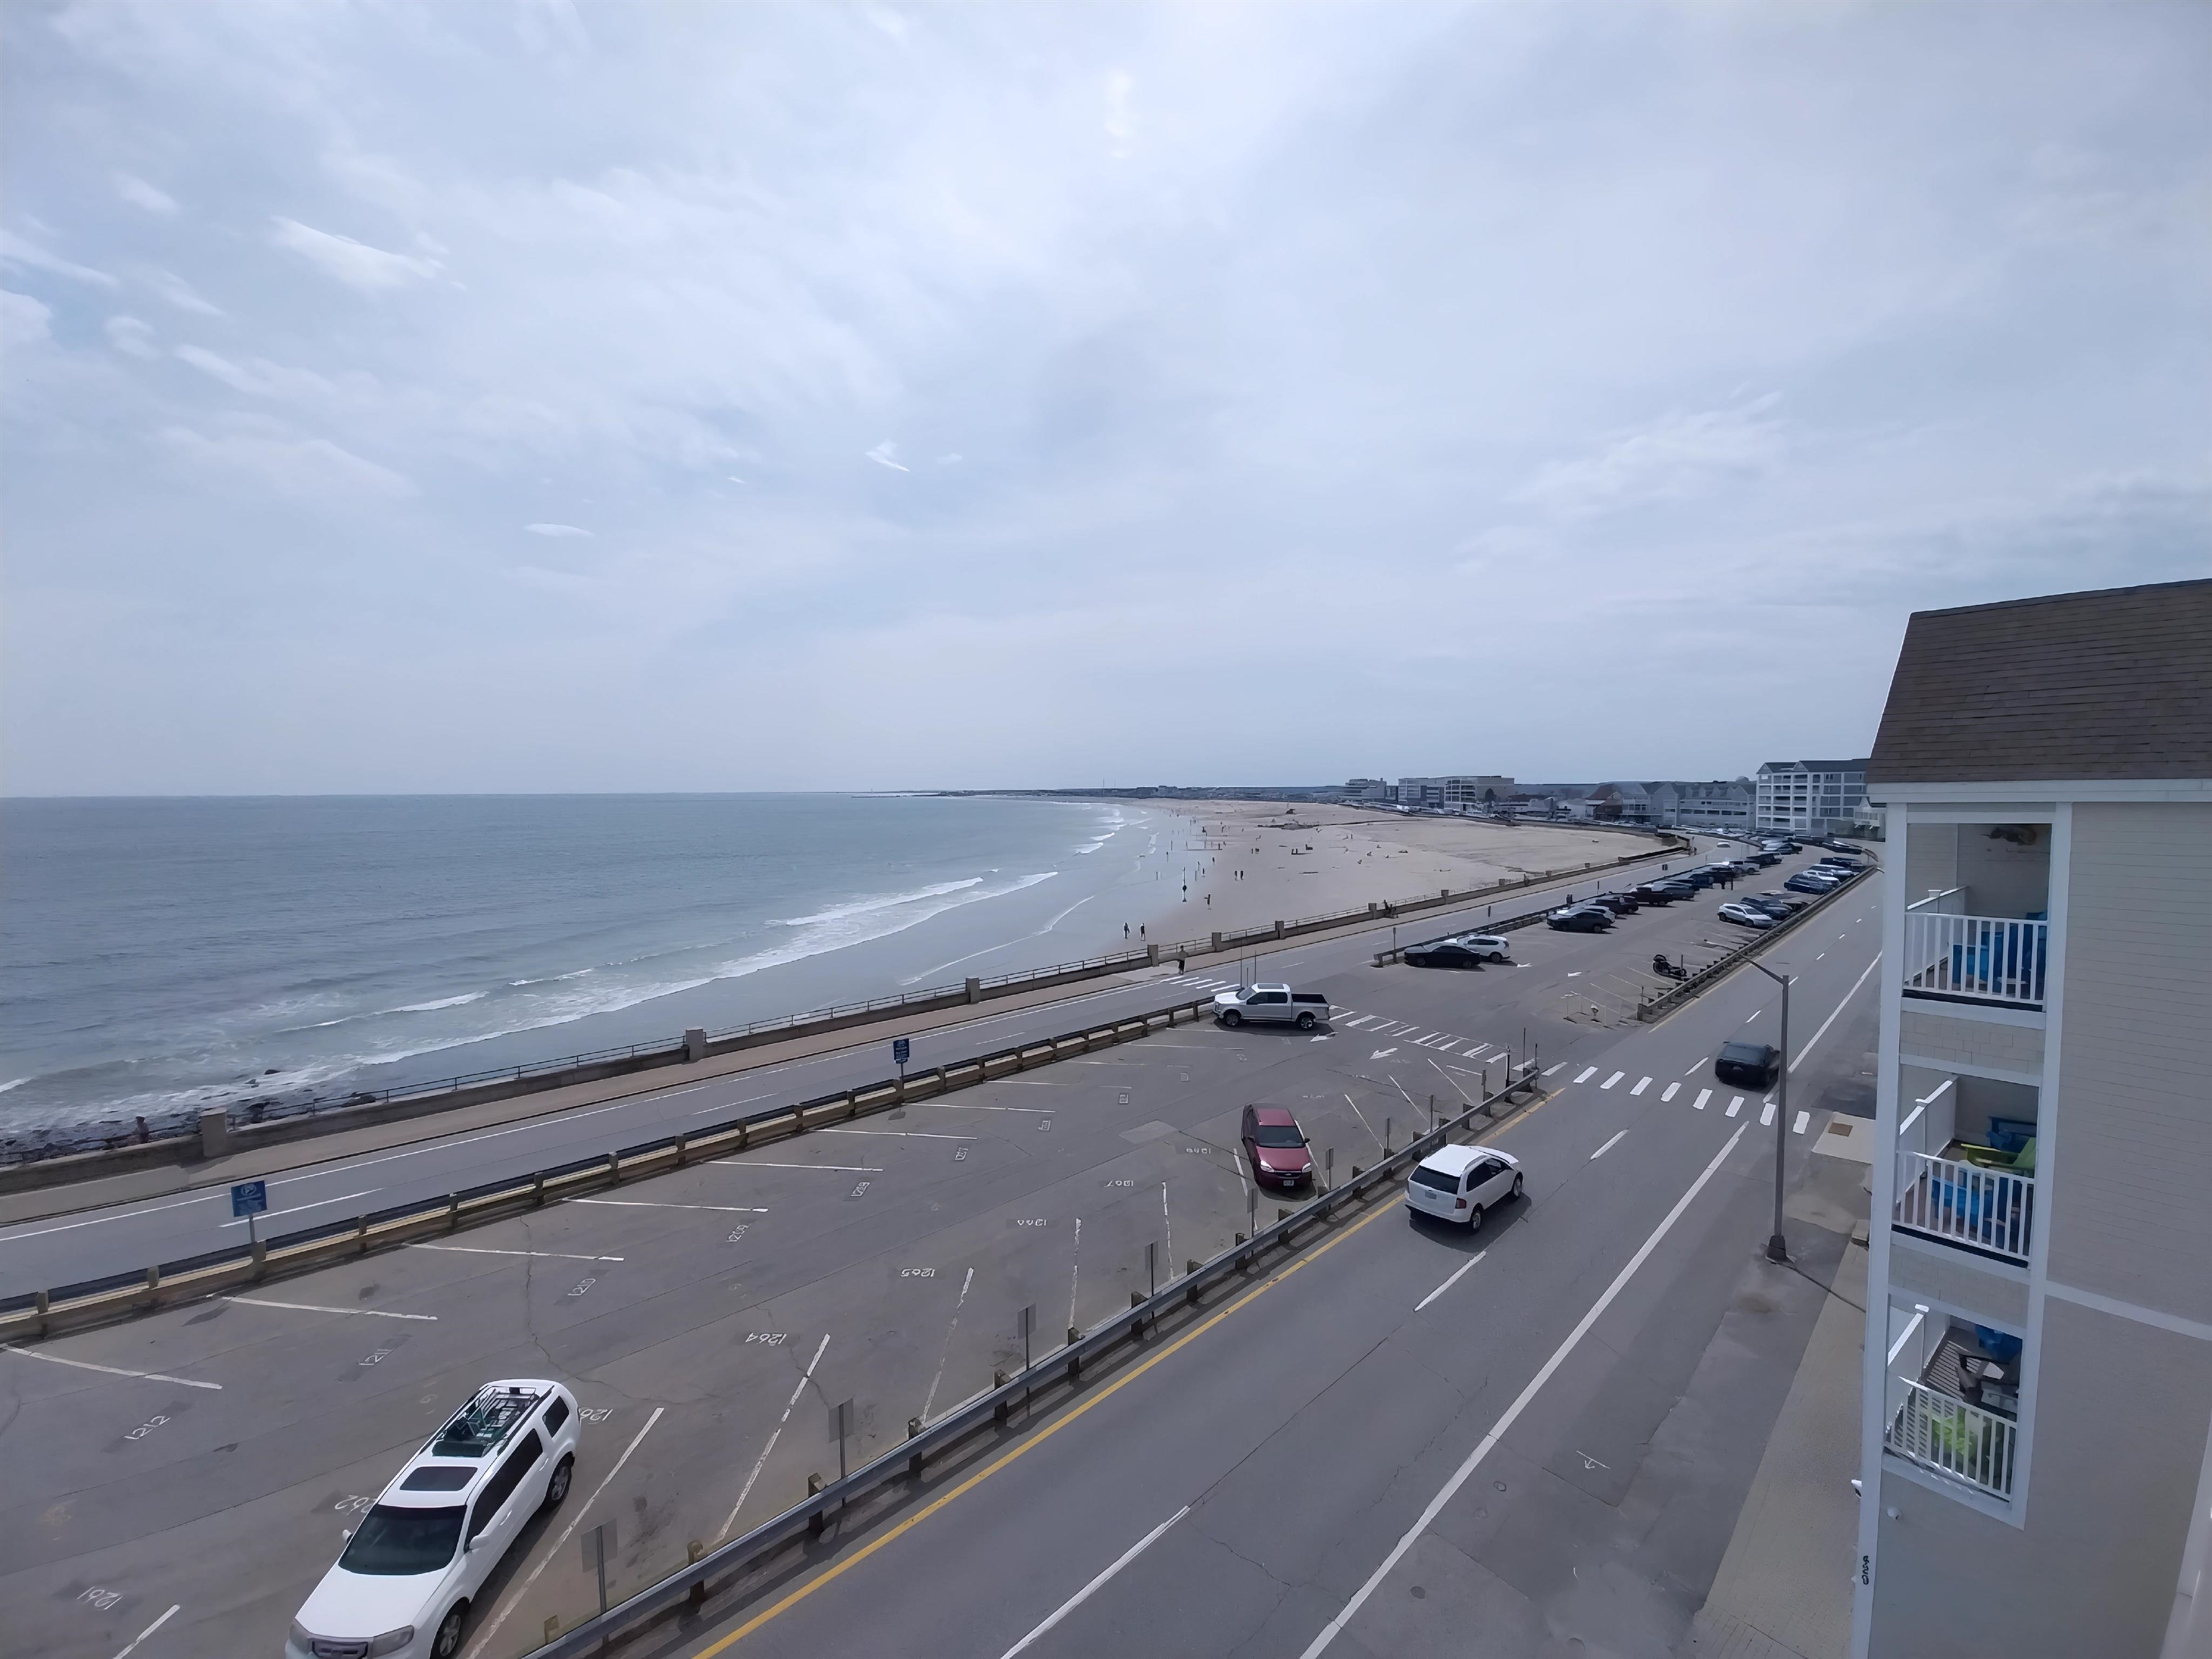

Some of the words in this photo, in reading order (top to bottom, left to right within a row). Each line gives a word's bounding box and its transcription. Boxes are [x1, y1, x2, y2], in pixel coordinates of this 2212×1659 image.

[745, 1332, 787, 1346] 1264
[359, 1348, 394, 1365] 1211
[579, 1407, 613, 1421] 126
[123, 1416, 171, 1439] 1212
[76, 1586, 123, 1610] 1261
